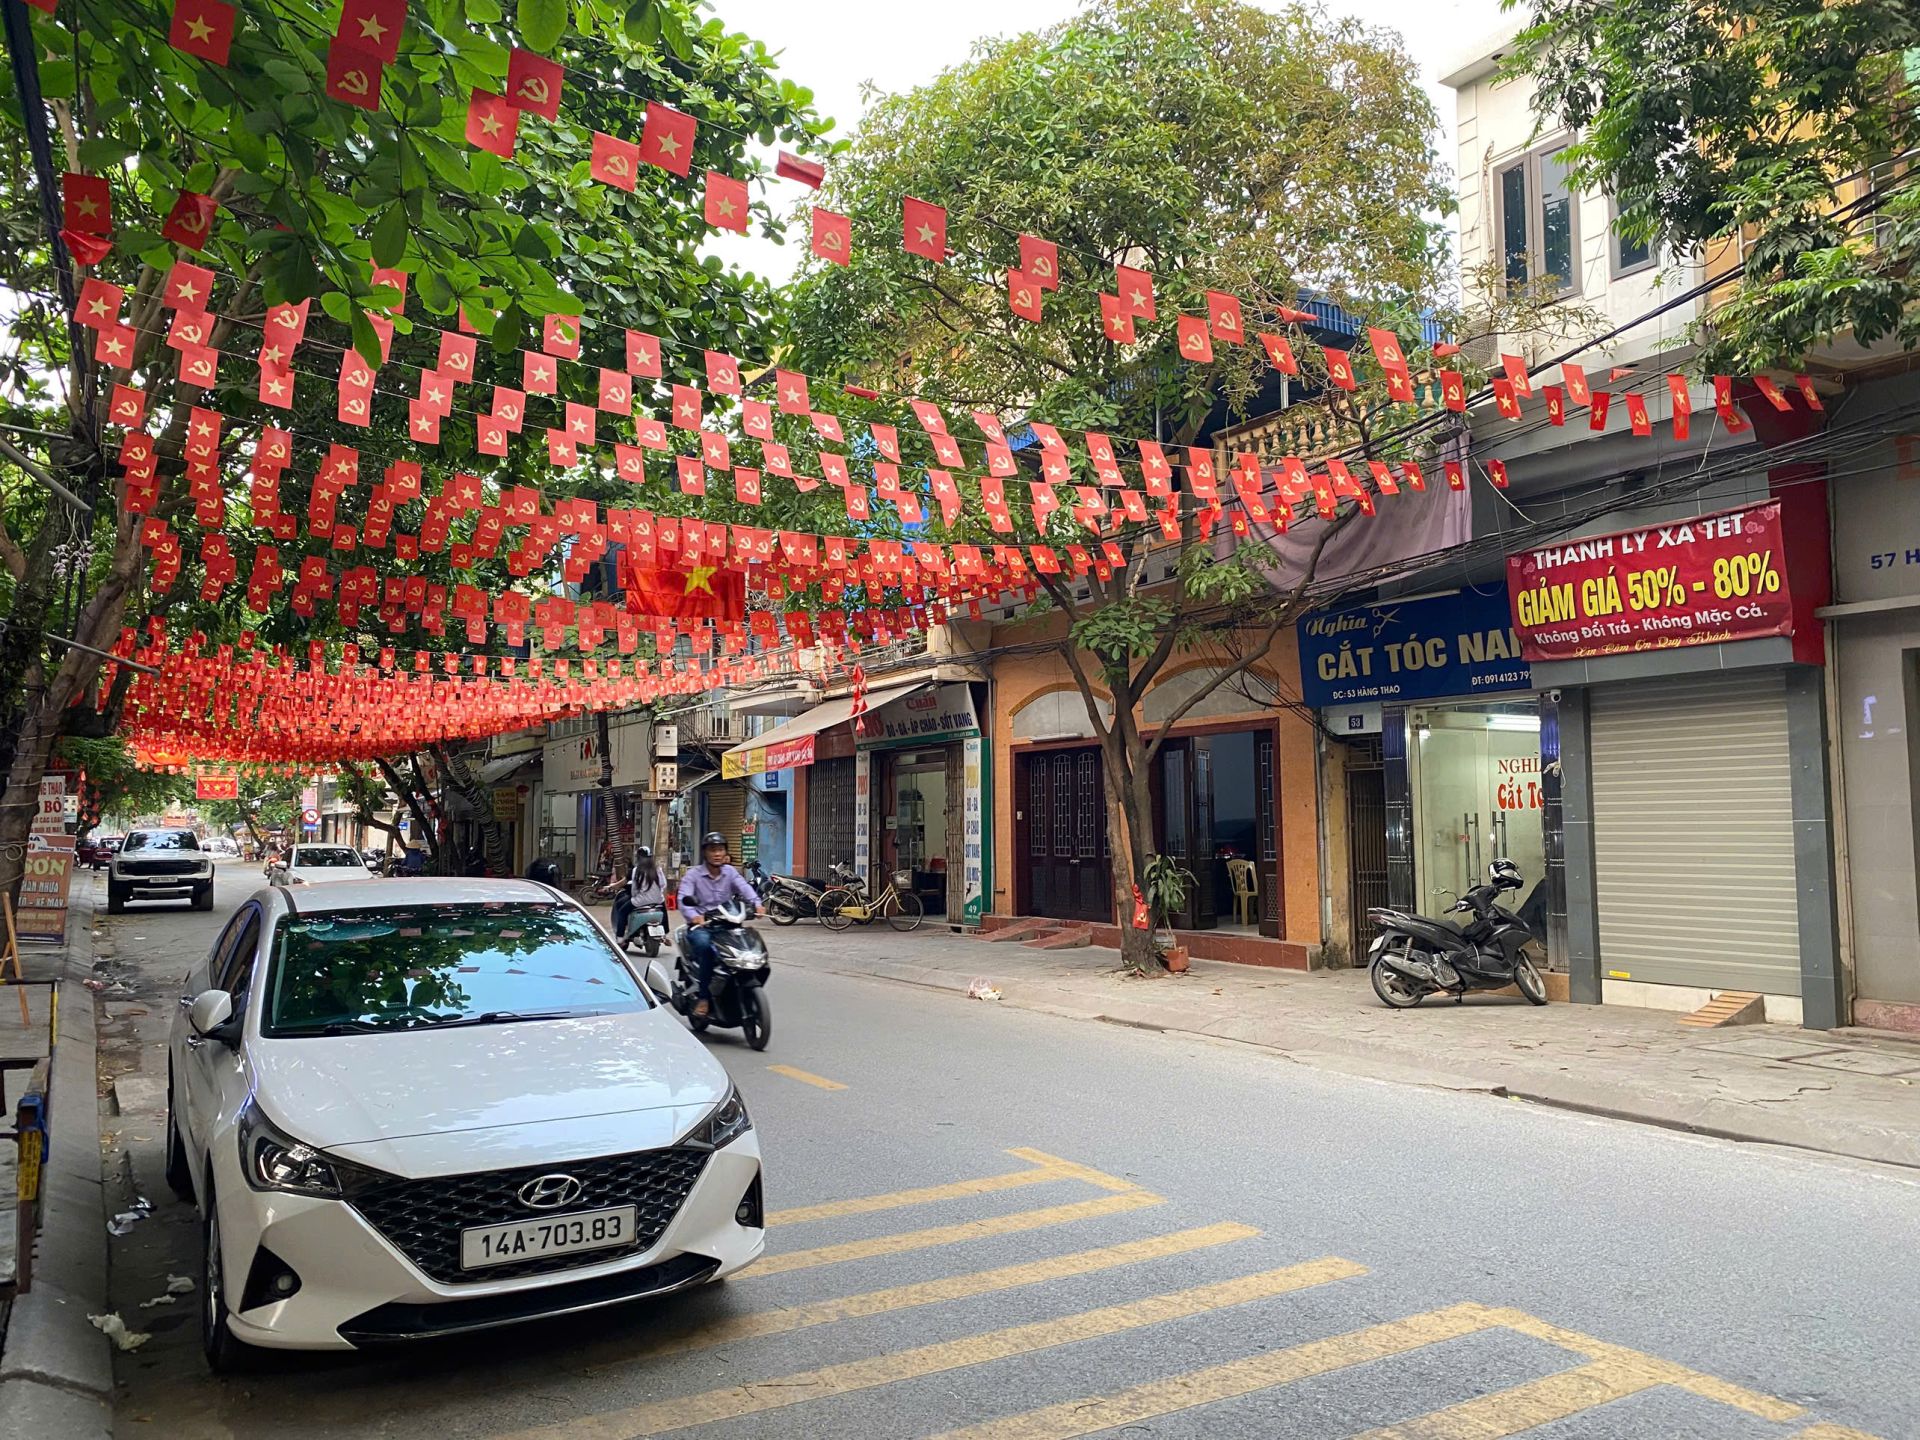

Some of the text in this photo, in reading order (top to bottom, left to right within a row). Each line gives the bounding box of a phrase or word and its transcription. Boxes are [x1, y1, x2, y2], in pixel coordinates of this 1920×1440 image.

[1533, 538, 1613, 570] THANH
[1871, 552, 1897, 570] 57
[1517, 550, 1780, 627] GIẢM GIÁ 50% - 80%
[1306, 614, 1369, 638] Nghĩa
[1535, 630, 1580, 644] Không
[1581, 620, 1607, 639] Đổi
[1607, 620, 1631, 635] Trả
[1642, 614, 1692, 631] Không
[1695, 608, 1732, 626] Mặc
[1736, 602, 1768, 619] Cả.
[1317, 640, 1374, 681] CẮT
[1384, 633, 1448, 673] TÓC
[1357, 686, 1379, 697] HÀNG
[1380, 685, 1400, 694] THAO
[940, 710, 953, 730] SỐT
[954, 711, 973, 729] VANG
[1350, 718, 1361, 728] 53
[1497, 776, 1524, 810] Cắt
[481, 1215, 622, 1258] 14A-703.83
